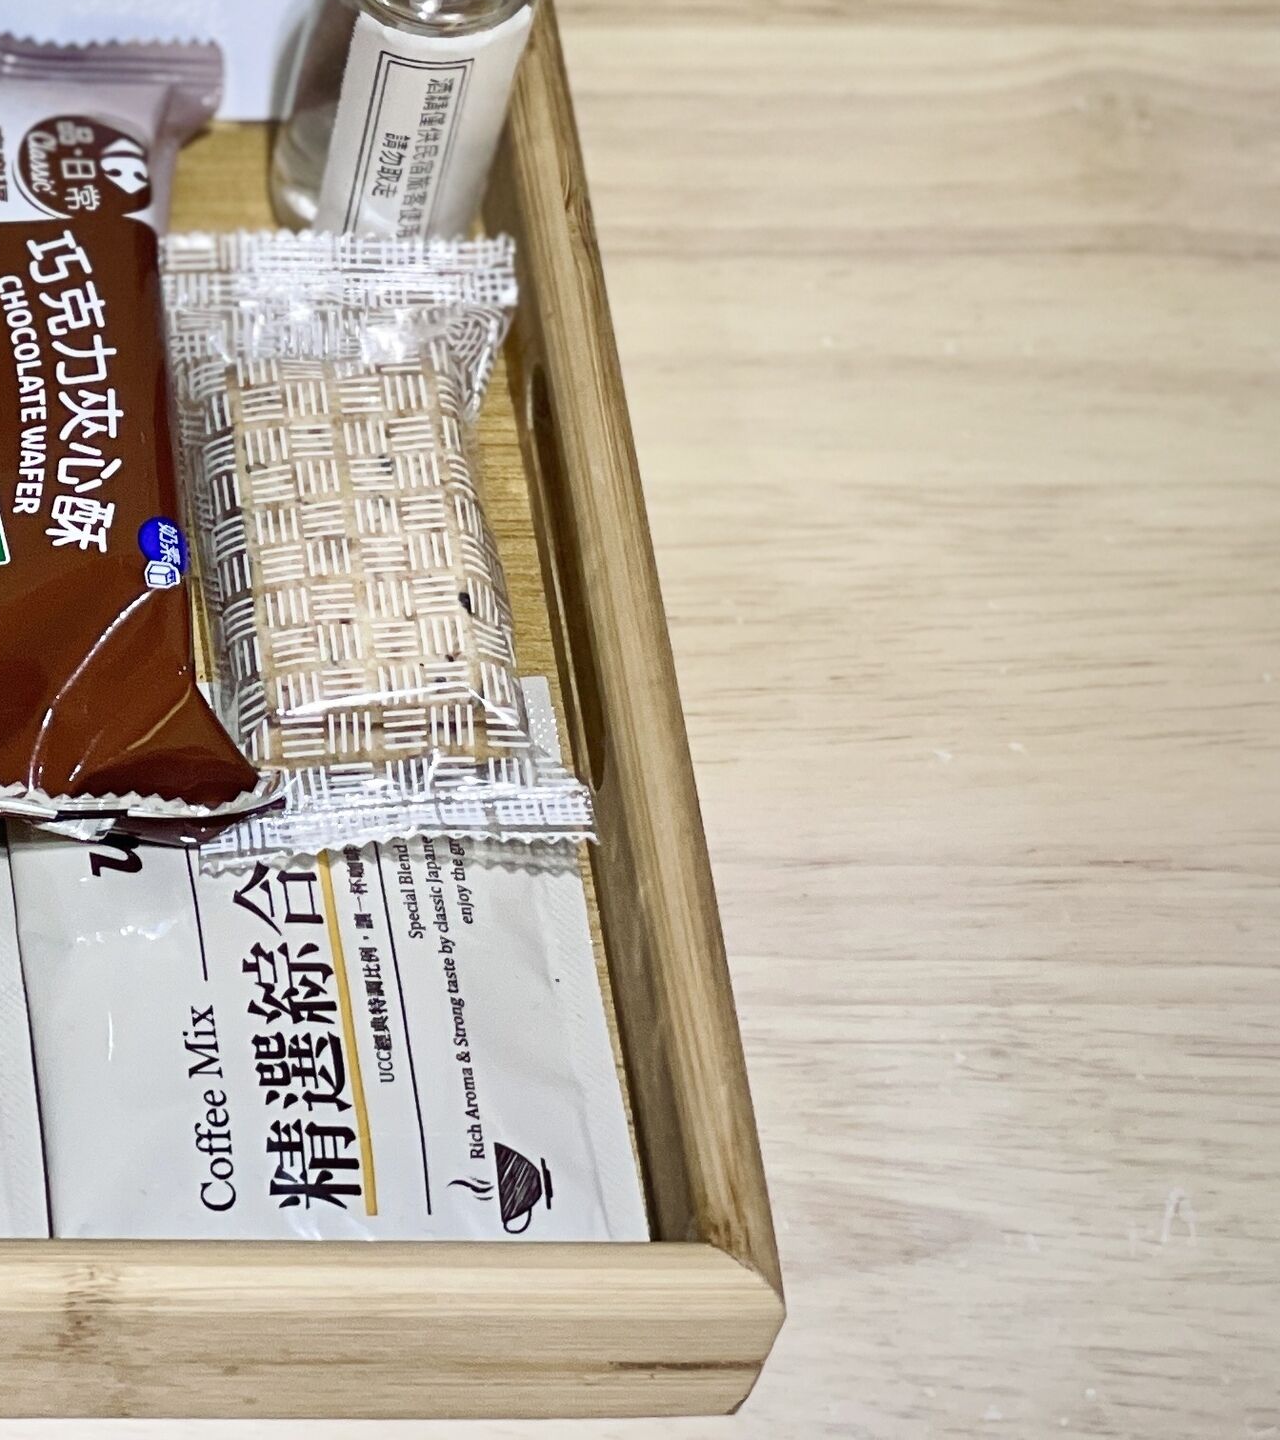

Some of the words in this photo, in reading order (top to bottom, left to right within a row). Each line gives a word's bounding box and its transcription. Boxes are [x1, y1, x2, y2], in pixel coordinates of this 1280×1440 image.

[371, 131, 411, 199] 請勿取走
[25, 228, 125, 554] 巧克力夾心酥
[12, 424, 48, 515] WAFER
[393, 843, 415, 887] Blend
[450, 858, 466, 882] the
[406, 887, 427, 940] Special
[429, 884, 450, 934] classic
[456, 884, 476, 925] enjoy
[438, 935, 456, 955] by
[442, 956, 460, 995] taste
[182, 1002, 224, 1080] Mix
[232, 860, 364, 1211] 精選綜合
[450, 996, 469, 1048] Strong
[455, 1050, 471, 1064] &
[462, 1067, 481, 1121] Aroma
[194, 1088, 238, 1212] Coffee
[467, 1122, 486, 1161] Rich
